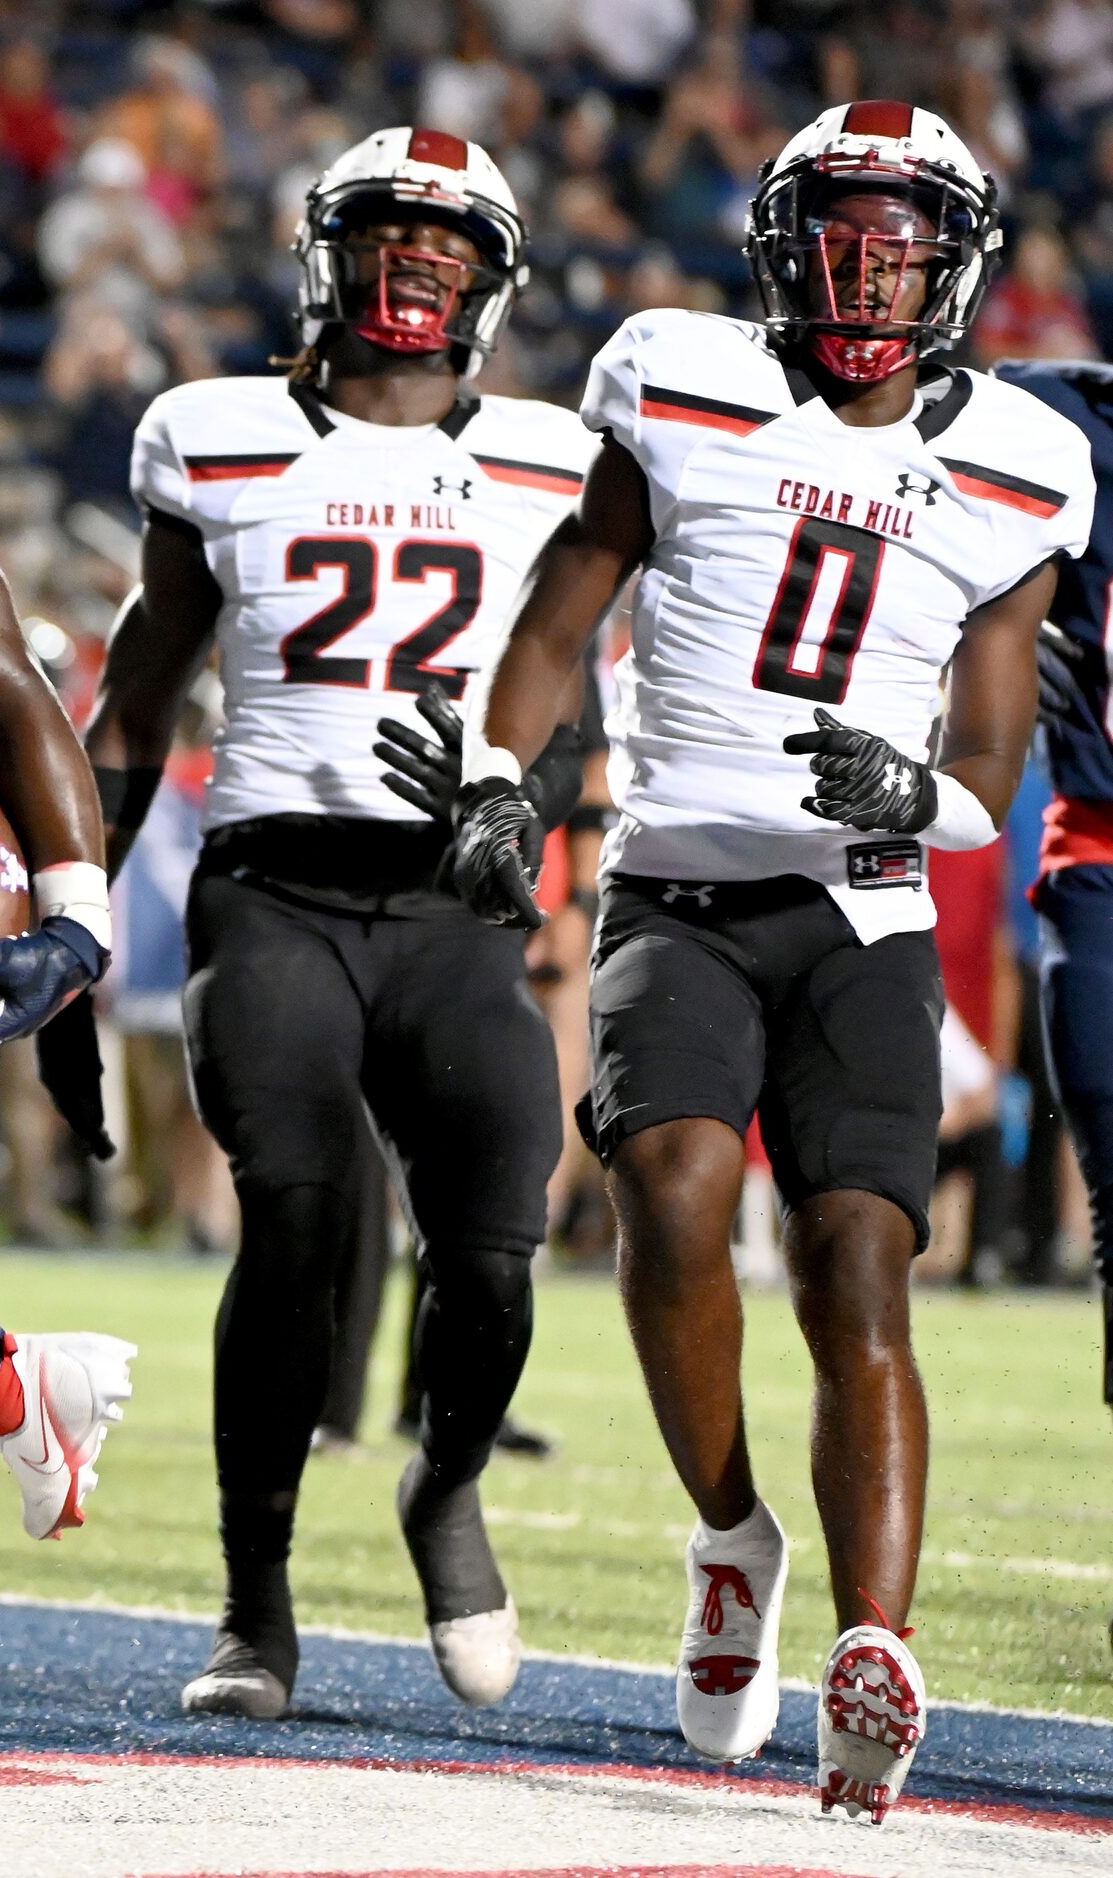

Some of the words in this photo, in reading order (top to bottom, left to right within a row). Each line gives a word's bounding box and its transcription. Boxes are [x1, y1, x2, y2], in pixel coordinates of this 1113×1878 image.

[326, 503, 395, 527] CEDAR
[410, 504, 457, 530] HILL
[776, 478, 854, 524] CEDAR
[863, 499, 914, 540] HILL
[279, 535, 483, 701] 22
[752, 515, 886, 705] 0
